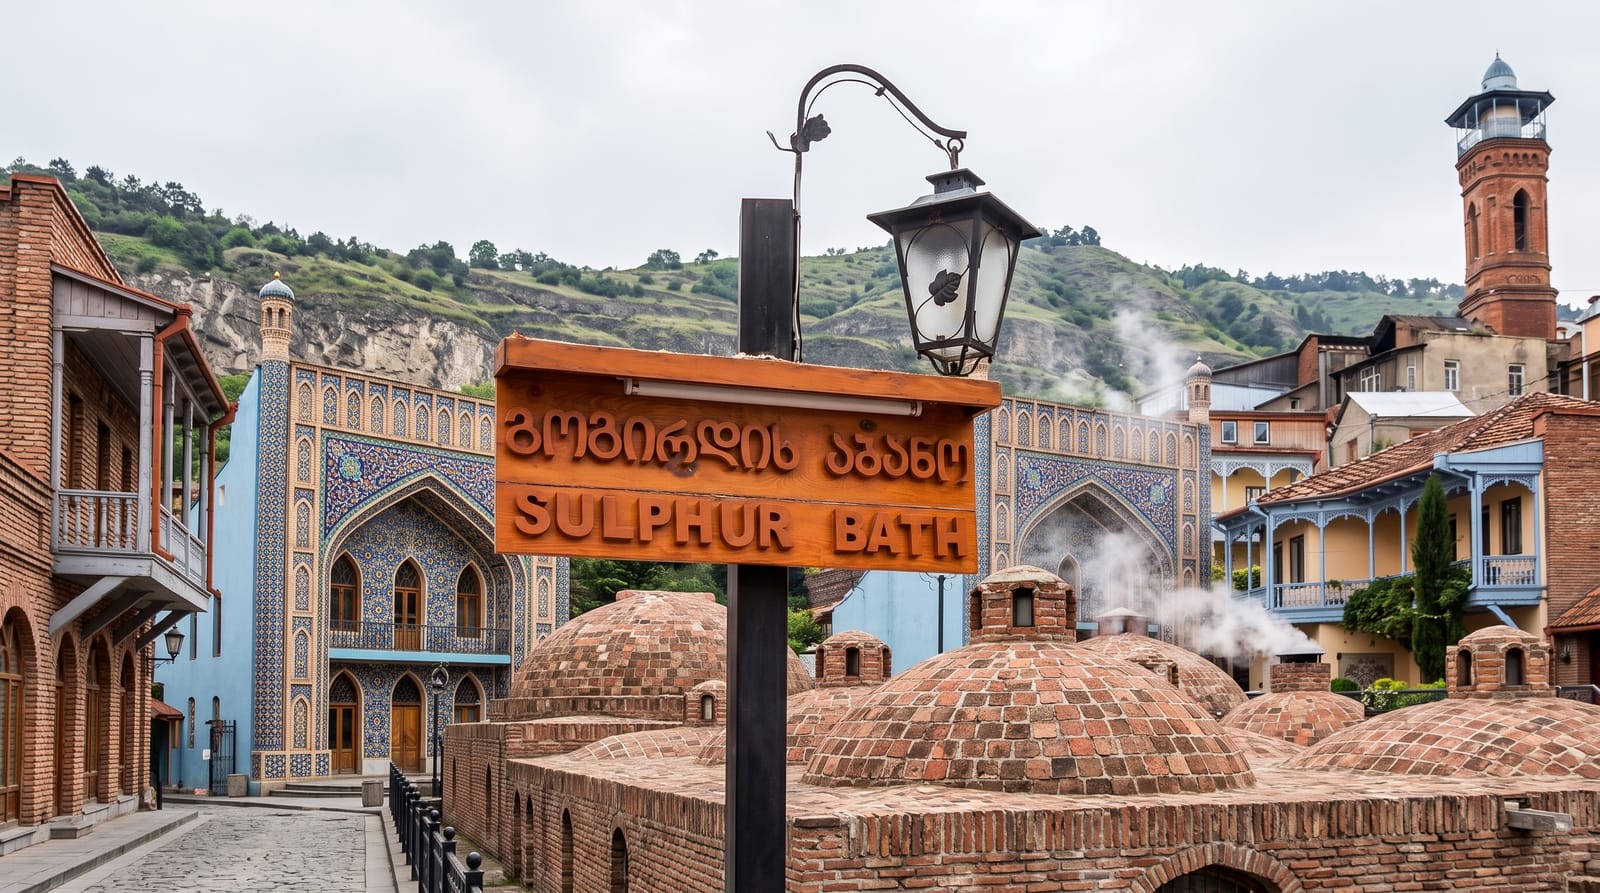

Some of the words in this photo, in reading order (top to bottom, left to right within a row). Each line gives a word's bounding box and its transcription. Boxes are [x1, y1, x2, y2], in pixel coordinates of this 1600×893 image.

[505, 407, 799, 472] გოგირდის
[826, 432, 968, 484] აბანო
[514, 491, 793, 548] SULPHUR
[833, 509, 968, 558] BATH
